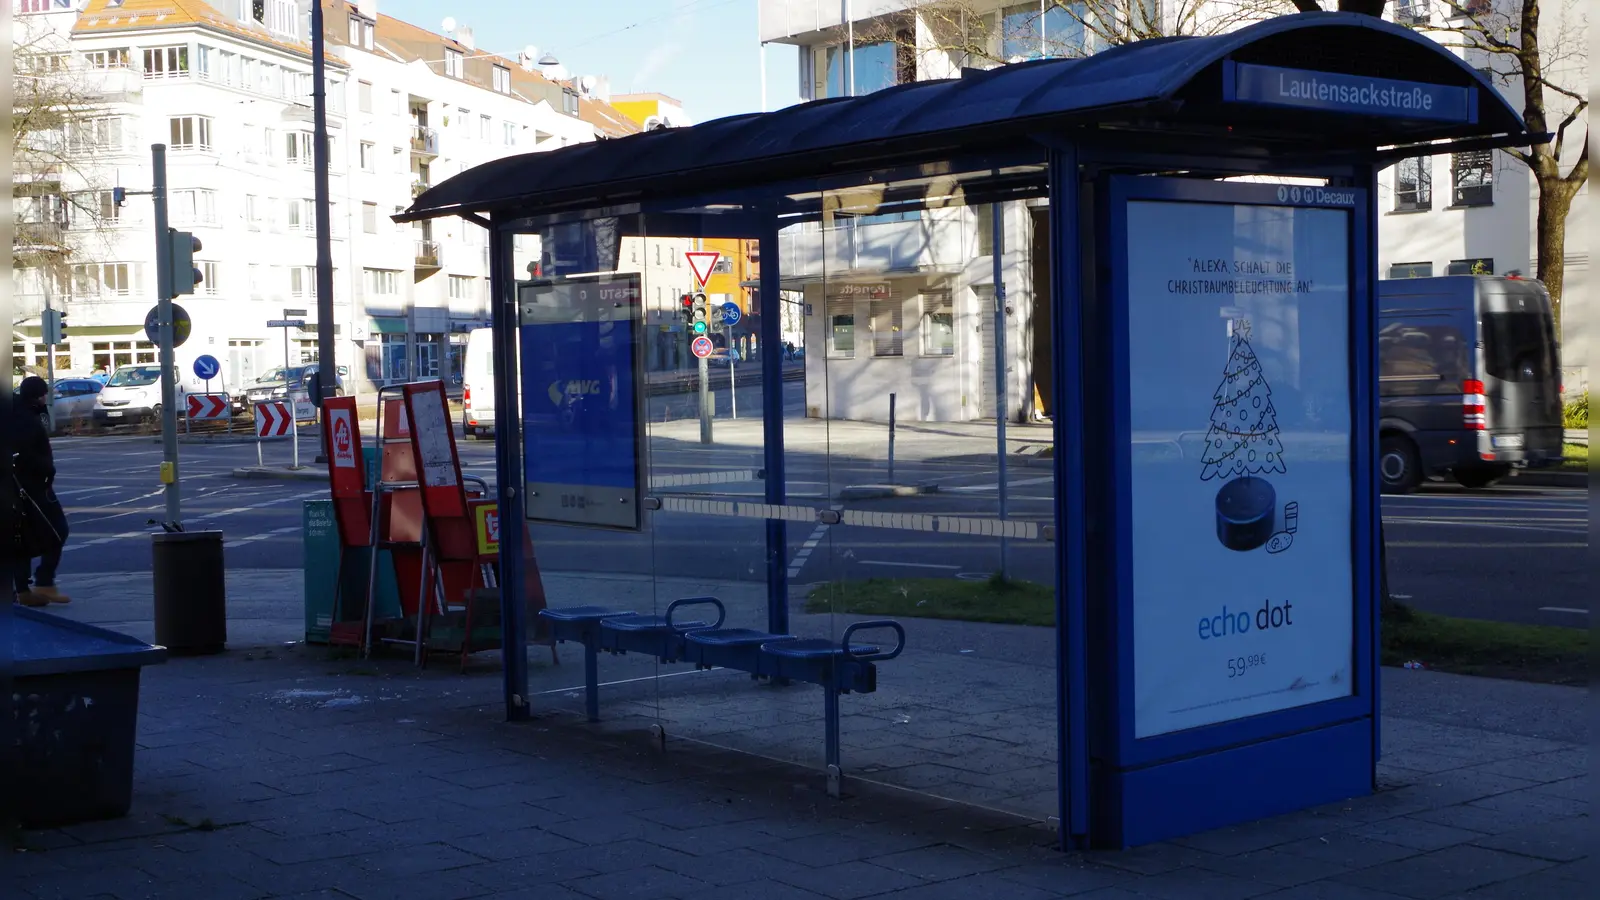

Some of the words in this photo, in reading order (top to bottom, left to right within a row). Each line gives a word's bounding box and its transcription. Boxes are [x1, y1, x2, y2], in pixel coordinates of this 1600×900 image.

[1279, 73, 1432, 110] Lautensackstraße
[1316, 189, 1355, 205] Decaux
[1234, 261, 1271, 274] SCHALT
[1276, 261, 1293, 275] DIE
[1167, 279, 1293, 295] CHRISTBAUMBELEUCHTUNG
[565, 379, 601, 395] MVG
[1198, 604, 1251, 640] echo
[1256, 599, 1293, 630] dot
